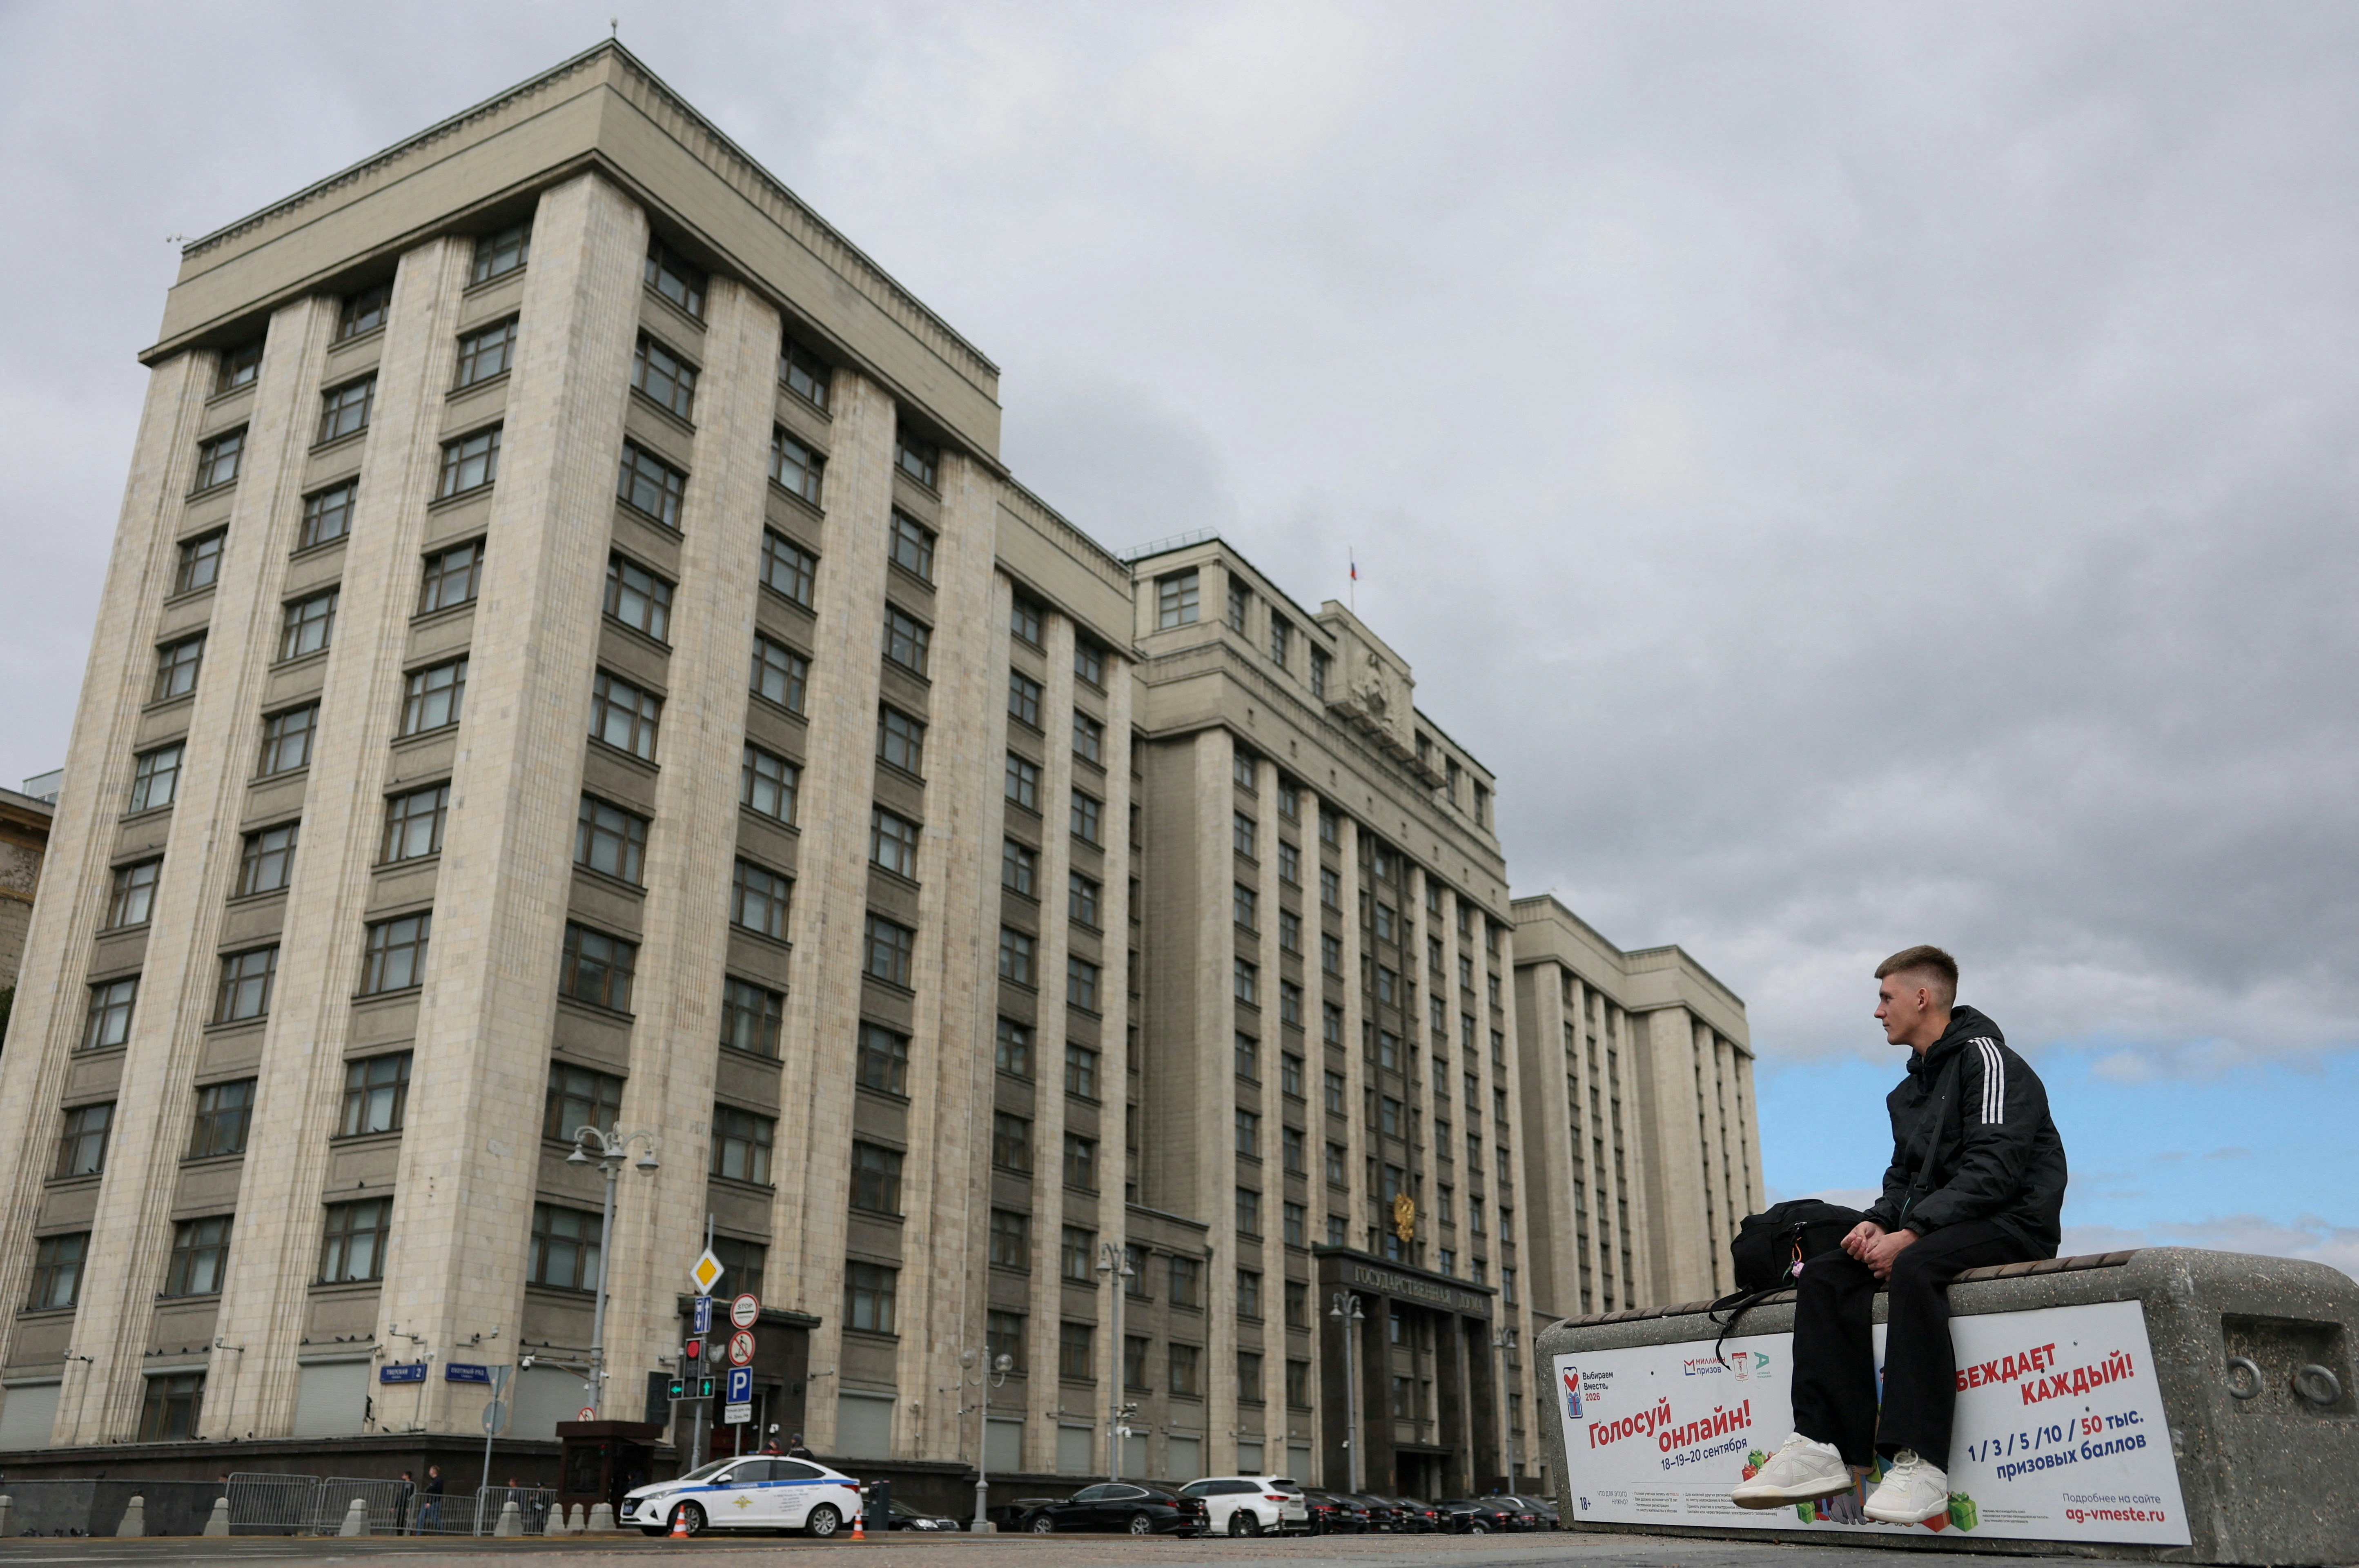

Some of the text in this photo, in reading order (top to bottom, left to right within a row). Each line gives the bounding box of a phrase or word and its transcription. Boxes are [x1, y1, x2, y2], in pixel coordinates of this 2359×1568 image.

[1354, 1265, 1484, 1312] ГОСУДАРСТВЕННАЯ ДУМА
[415, 1368, 422, 1378] 2
[1582, 1372, 1613, 1381] Выбираем
[1697, 1367, 1722, 1376] призов
[2020, 1349, 2134, 1406] КАЖДЫЙ!
[1585, 1393, 1600, 1401] 2026
[1589, 1396, 1671, 1449] Голосуй
[1659, 1399, 1752, 1452] онлайн!
[1968, 1446, 1976, 1461] 1
[1992, 1439, 2002, 1456] 3
[2020, 1433, 2029, 1450] 5
[2081, 1415, 2103, 1435] 50
[2105, 1410, 2144, 1430] тыс.
[1703, 1437, 1747, 1459] сентября
[1996, 1434, 2147, 1482] призовых баллов
[1580, 1497, 1591, 1510] 18+
[2063, 1493, 2116, 1505] Подробнее
[2133, 1494, 2161, 1503] сайте
[2066, 1507, 2165, 1523] ag-vmeste.ru
